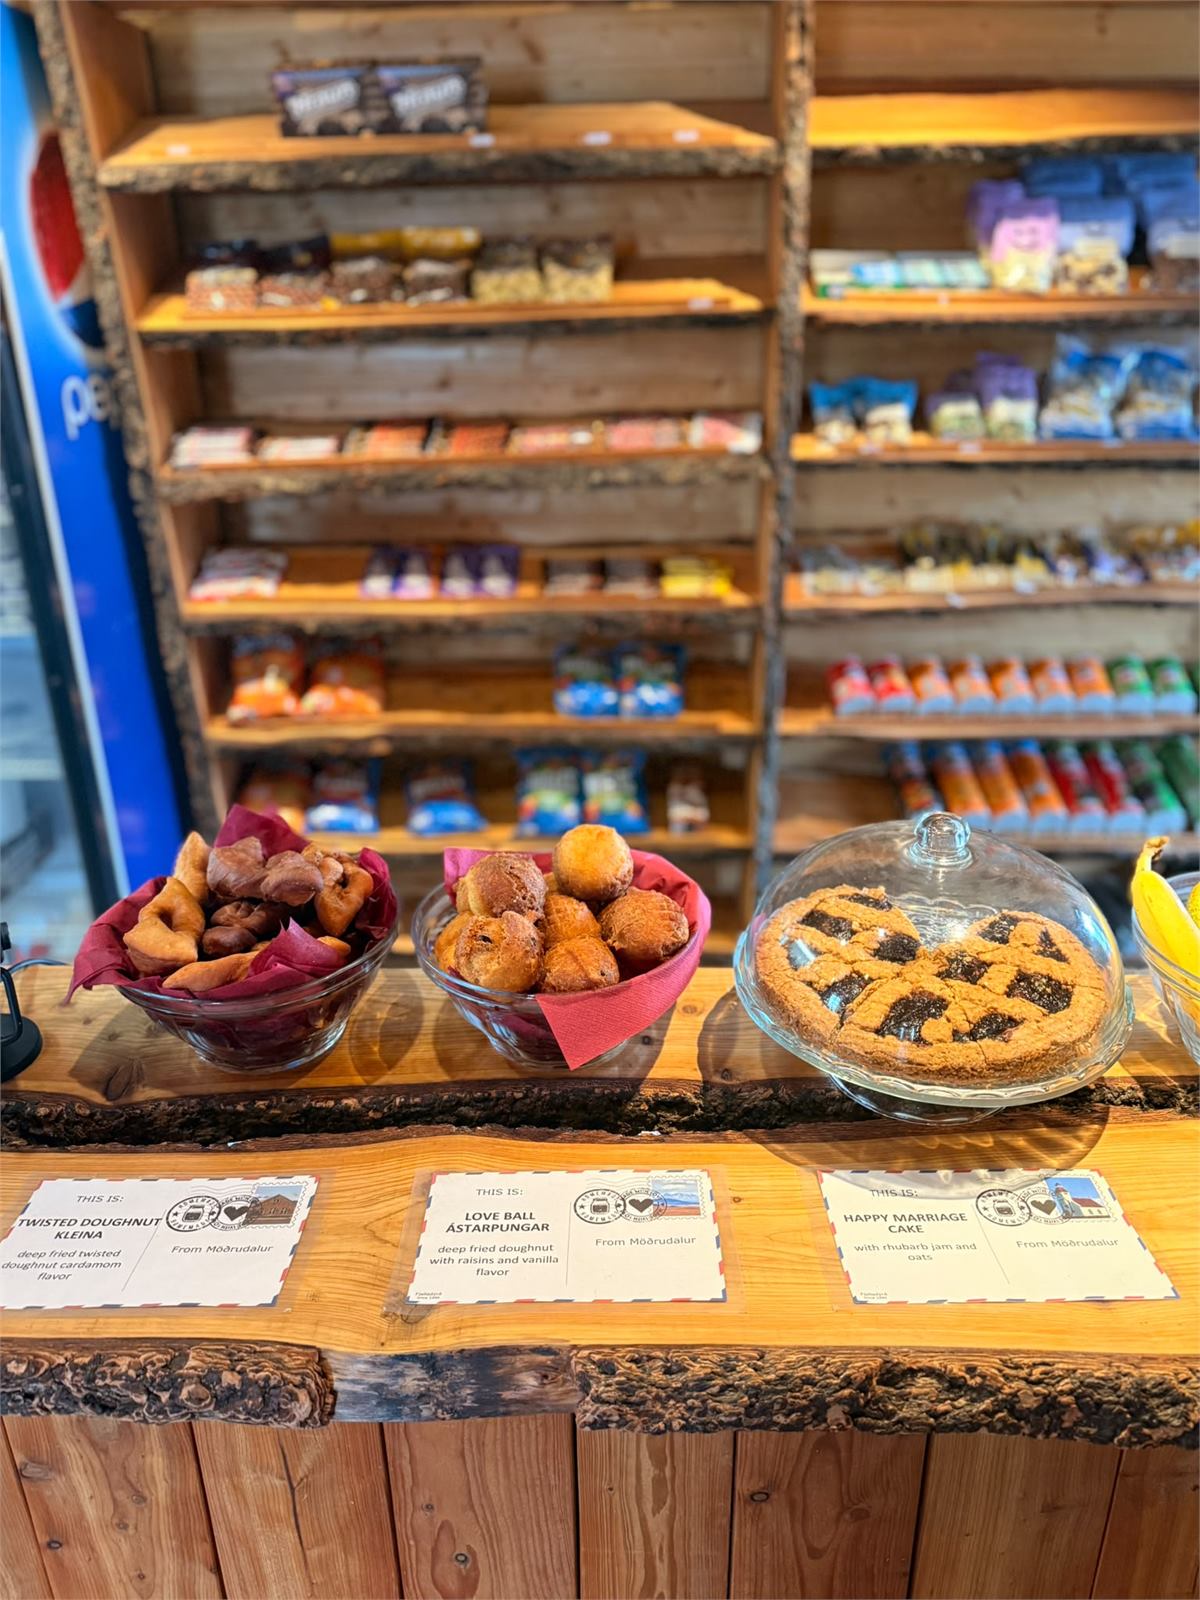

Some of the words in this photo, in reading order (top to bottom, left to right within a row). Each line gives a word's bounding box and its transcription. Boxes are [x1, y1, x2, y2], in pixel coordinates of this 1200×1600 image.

[477, 1188, 503, 1196] THIS
[507, 1188, 523, 1196] IS:
[870, 1189, 898, 1197] THIS
[901, 1189, 918, 1197] IS:
[77, 1195, 104, 1203] THIS
[106, 1195, 124, 1203] IS:
[464, 1211, 501, 1221] LOVE
[503, 1211, 536, 1221] BALL
[843, 1213, 889, 1223] HAPPY
[892, 1212, 968, 1222] MARRIAGE
[17, 1218, 79, 1227] TWISTED
[79, 1217, 163, 1227] DOUGHNUT
[445, 1220, 550, 1233] ÁSTARPUNGAR
[887, 1224, 925, 1234] CAKE
[54, 1230, 103, 1240] KLEINA
[595, 1238, 626, 1246] From
[629, 1235, 697, 1246] Möðrudalur
[1016, 1240, 1048, 1248] From
[171, 1245, 202, 1254] From
[206, 1243, 274, 1253] Möðrudalur
[437, 1246, 467, 1255] deep
[469, 1244, 496, 1253] fried
[498, 1244, 554, 1254] doughnut
[853, 1243, 880, 1252] with
[882, 1243, 929, 1251] rhubarb
[930, 1243, 953, 1252] jam
[17, 1250, 46, 1260] deep
[47, 1249, 77, 1259] fried
[78, 1249, 122, 1258] twisted
[1, 1261, 58, 1270] doughnut
[59, 1260, 122, 1269] cardamom
[429, 1256, 455, 1265] with
[457, 1256, 495, 1265] raisins
[497, 1256, 519, 1265] and
[521, 1255, 559, 1264] vanilla
[36, 1271, 73, 1281] flavor
[476, 1267, 510, 1276] flavor
